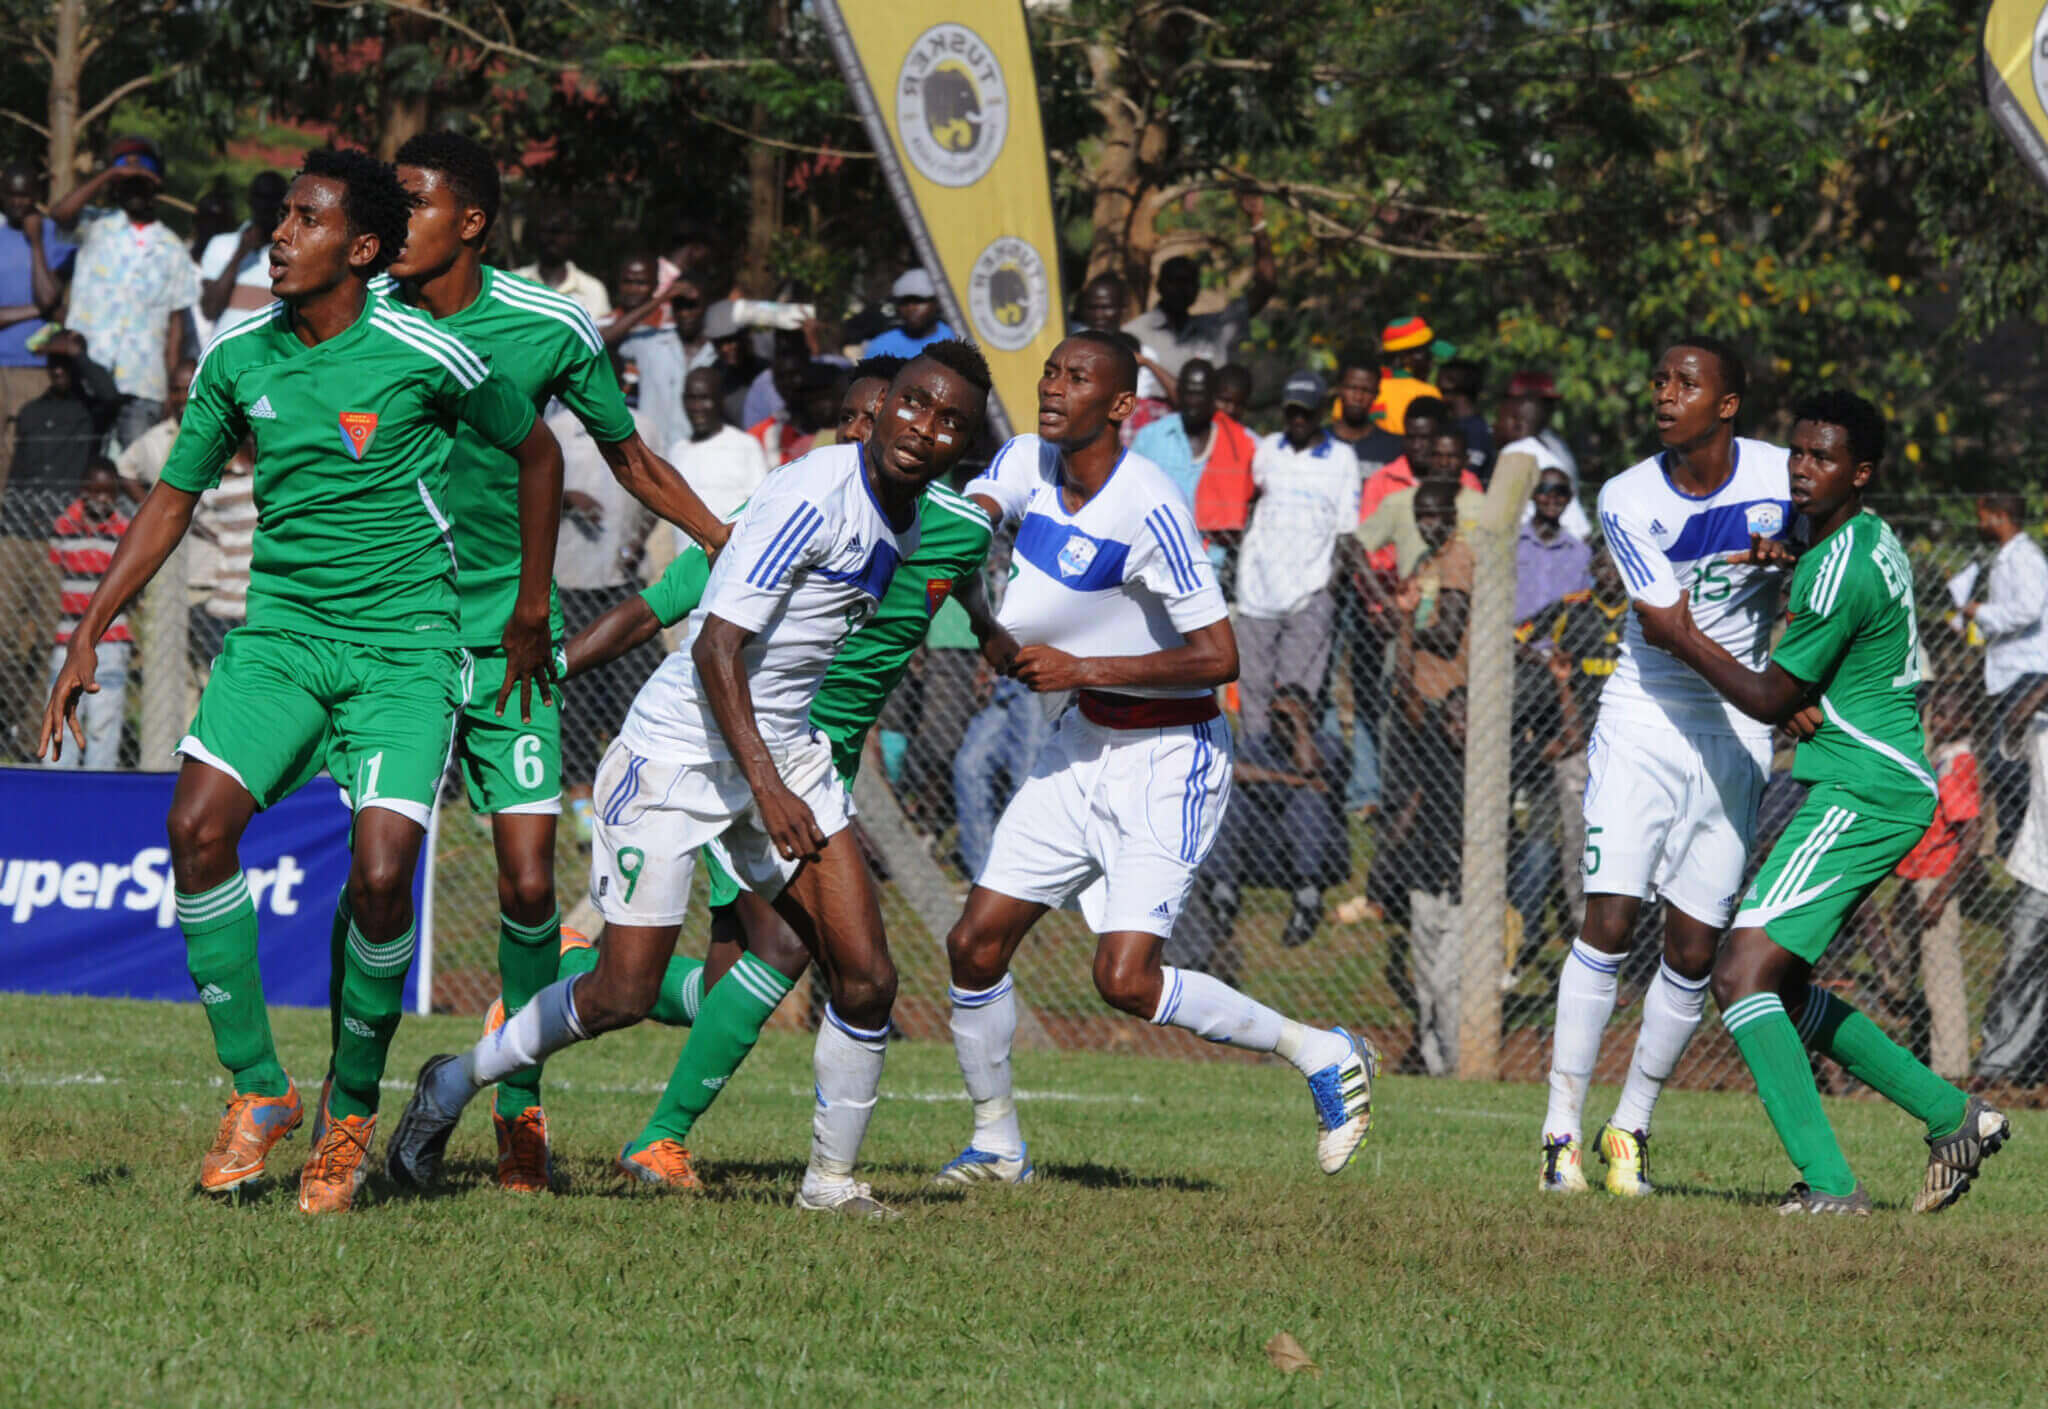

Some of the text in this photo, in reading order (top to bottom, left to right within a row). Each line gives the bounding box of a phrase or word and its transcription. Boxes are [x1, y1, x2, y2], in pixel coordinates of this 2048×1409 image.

[1692, 560, 1731, 603] 15
[513, 734, 544, 789] 6
[616, 846, 645, 904] 9
[1585, 826, 1603, 875] 5
[0, 847, 305, 928] uperSrt
